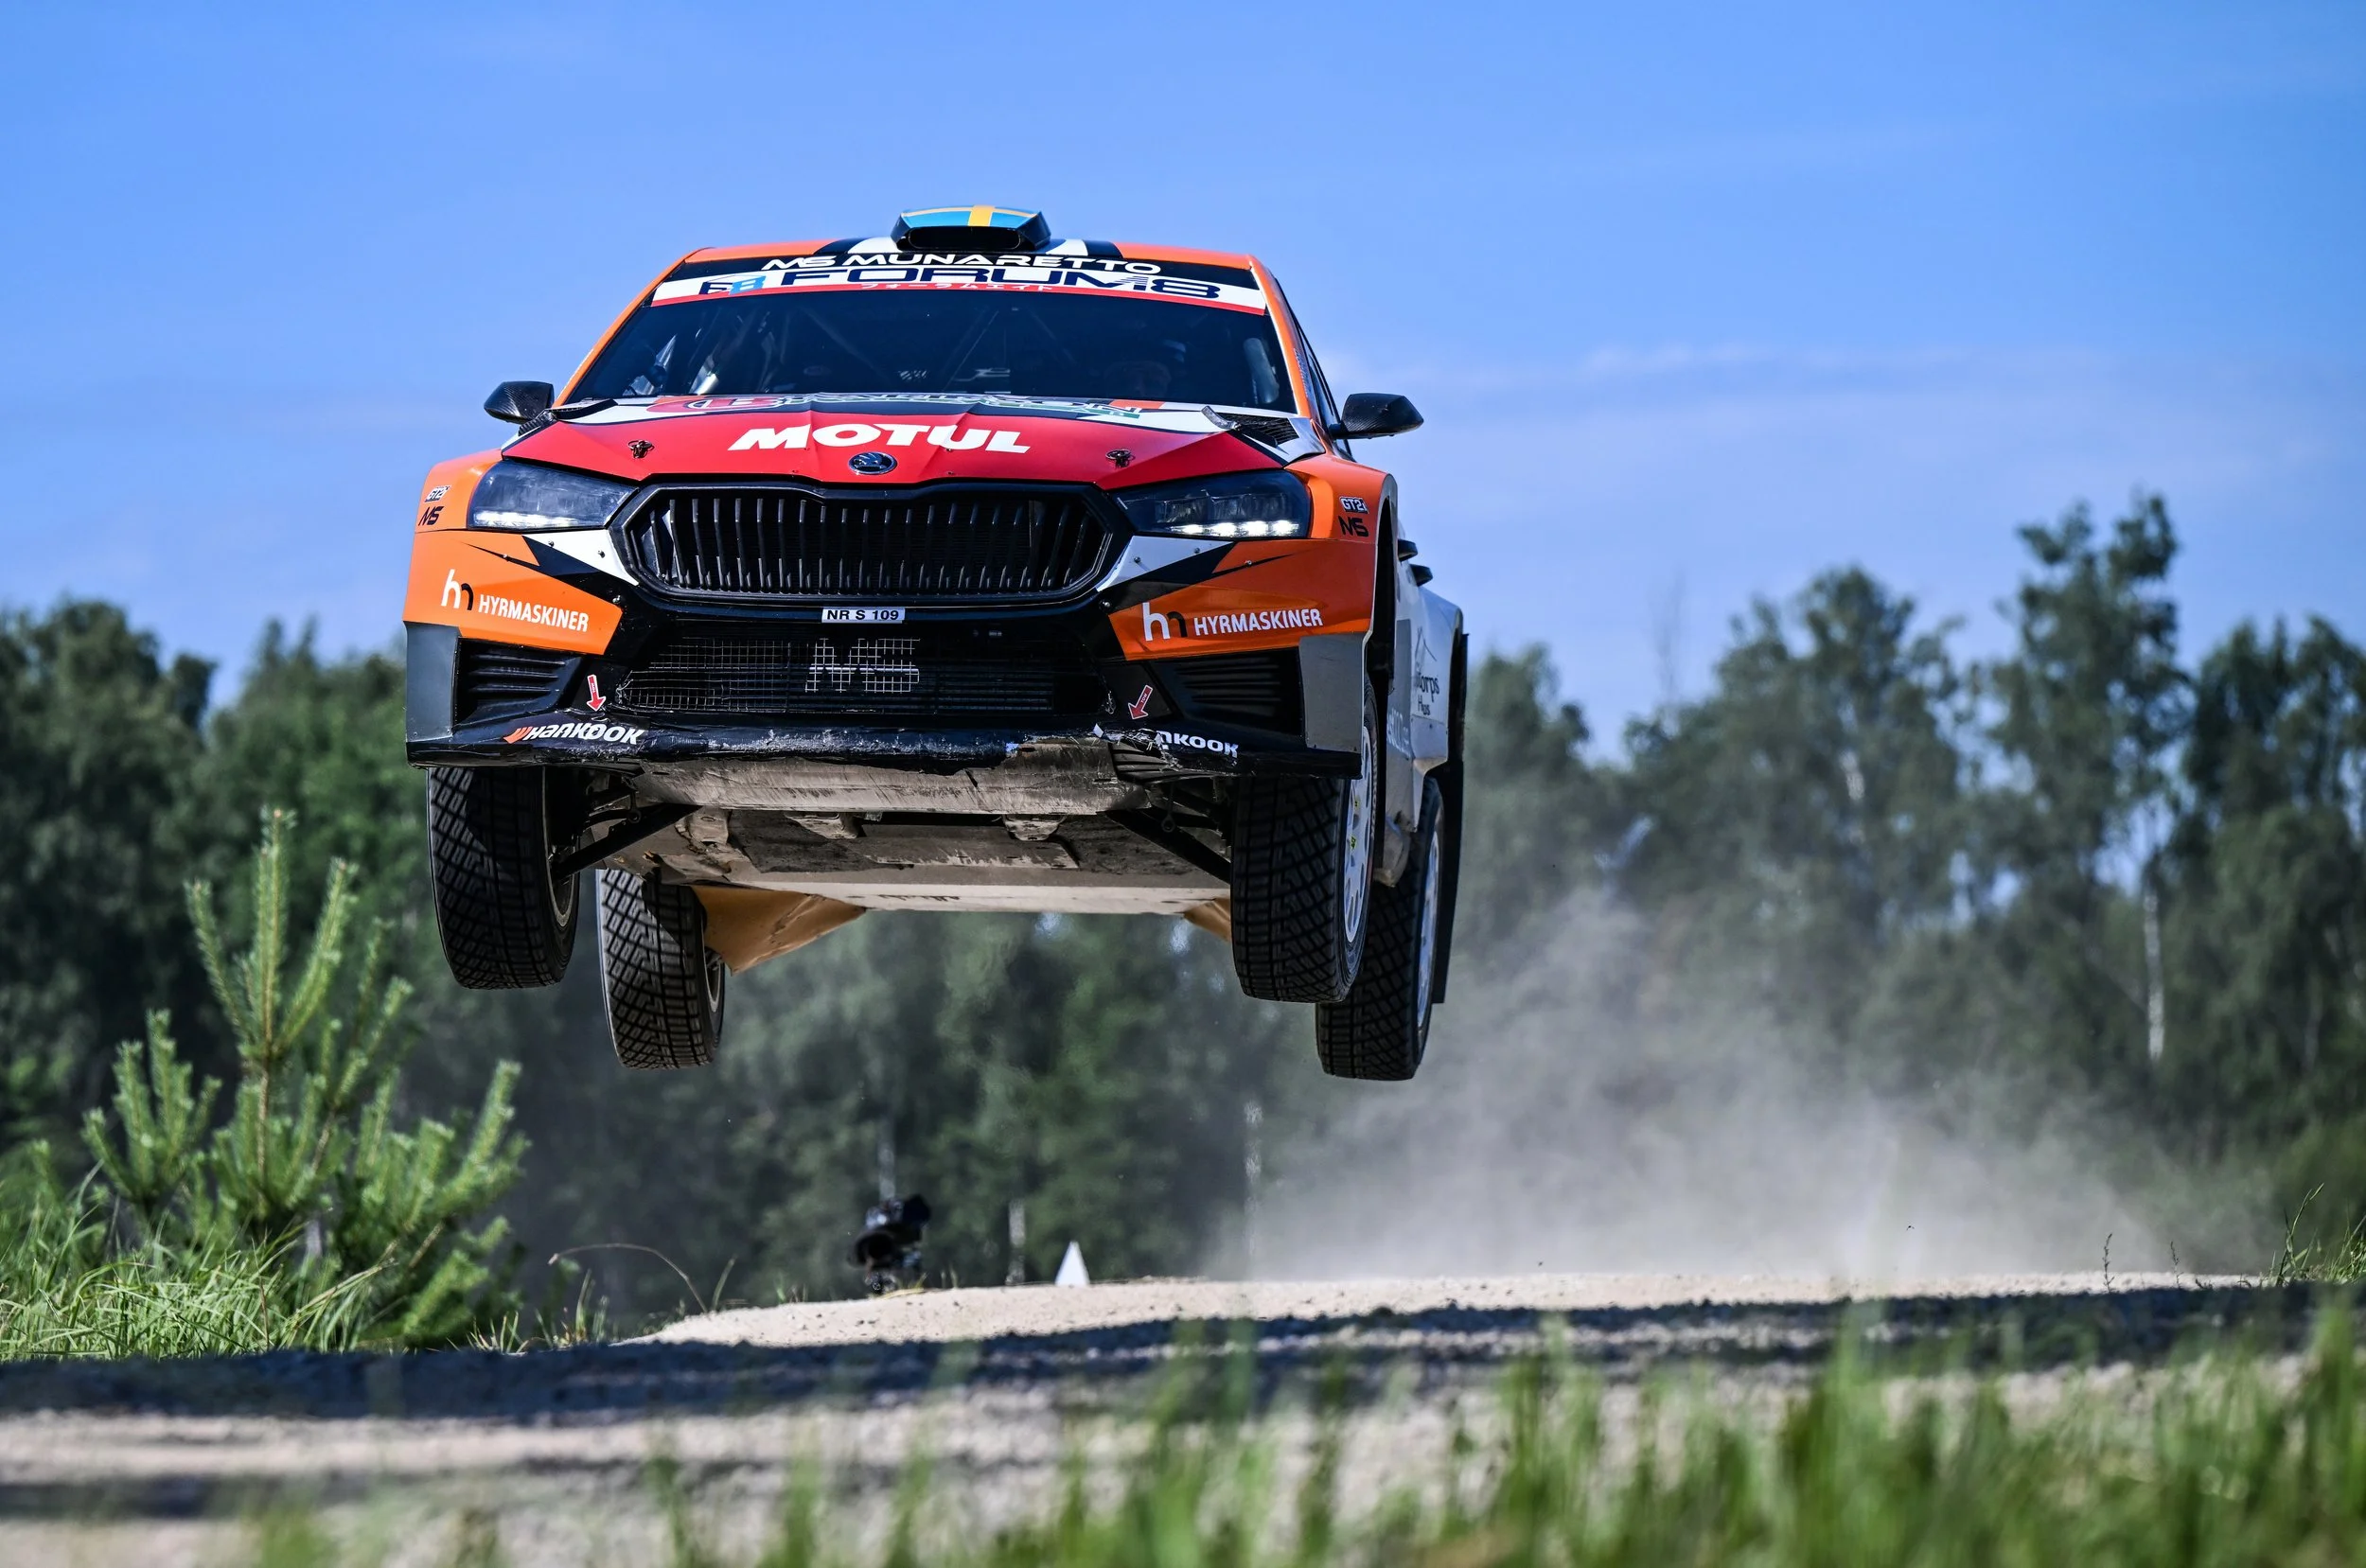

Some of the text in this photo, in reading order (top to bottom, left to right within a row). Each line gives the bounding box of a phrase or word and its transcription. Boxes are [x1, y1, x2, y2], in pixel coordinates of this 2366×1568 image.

[761, 254, 1161, 274] MS MUNARETTO
[781, 268, 1221, 299] FORUM8
[860, 283, 1053, 292] フォーラムエイト
[727, 423, 1031, 454] MOTUL
[417, 505, 445, 526] MS
[1337, 515, 1369, 537] MS
[477, 593, 589, 632] HYRMASKINER
[826, 609, 899, 621] NR S 109
[1193, 608, 1323, 636] HYRMASKINER
